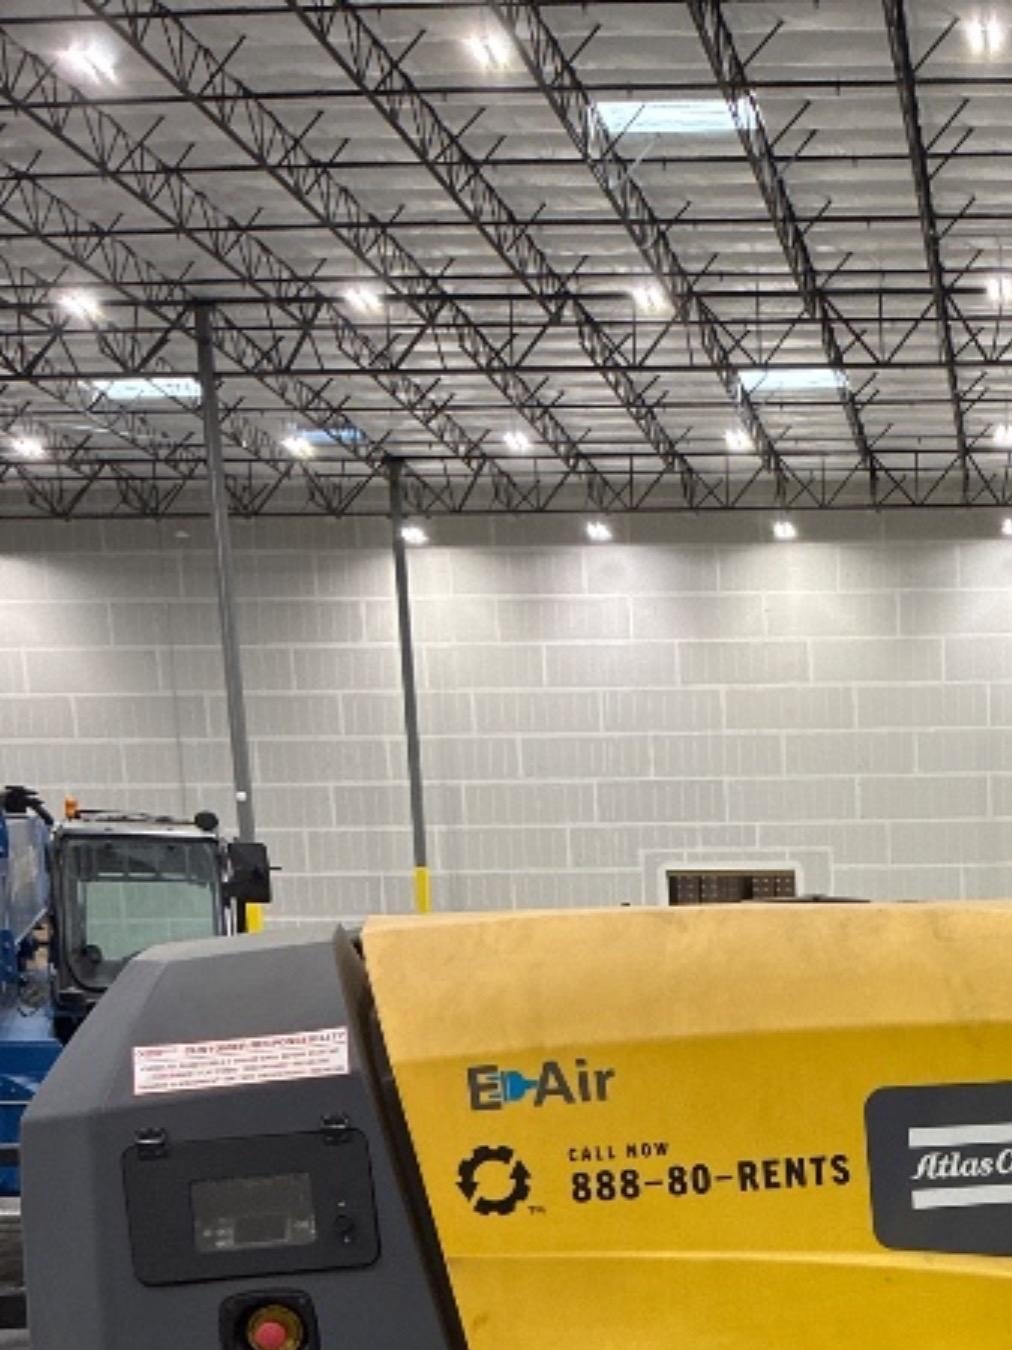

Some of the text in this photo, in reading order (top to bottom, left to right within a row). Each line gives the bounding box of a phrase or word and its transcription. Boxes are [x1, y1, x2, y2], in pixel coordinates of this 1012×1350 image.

[568, 1142, 670, 1162] CALL NOW
[911, 1151, 994, 1180] Atlas
[571, 1154, 851, 1203] 888-80-RENTS
